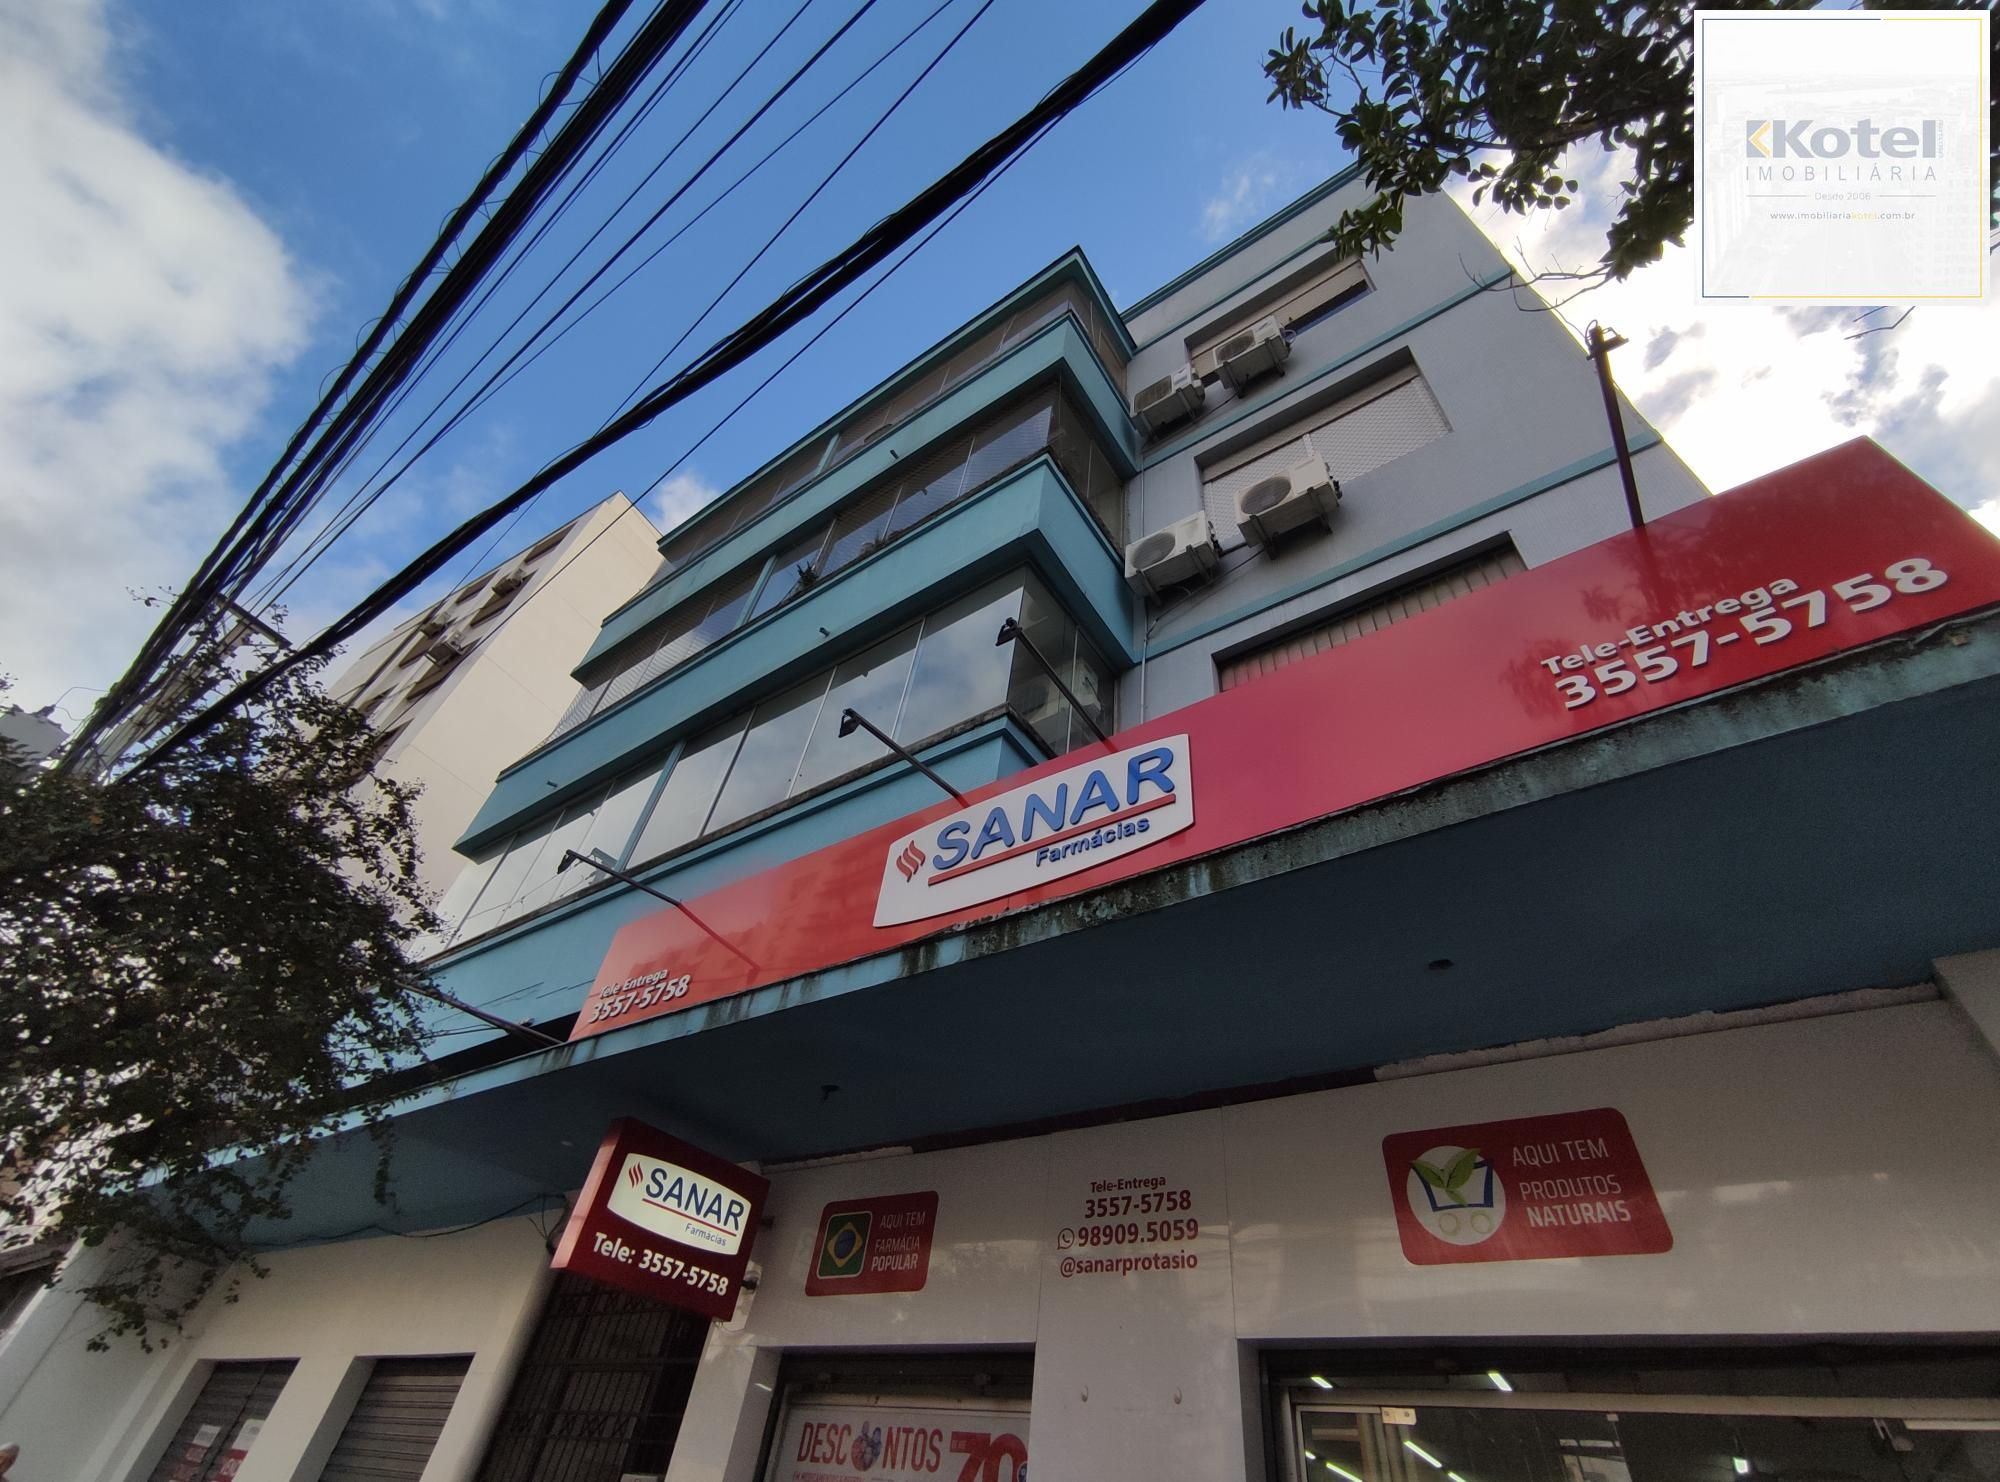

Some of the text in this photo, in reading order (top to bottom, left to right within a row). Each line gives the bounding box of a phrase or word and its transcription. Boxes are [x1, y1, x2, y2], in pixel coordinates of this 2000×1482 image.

[1541, 577, 1799, 675] Tele-Entrega
[1555, 558, 1948, 710] 3557-5758
[932, 747, 1175, 870] SANAR
[1035, 817, 1150, 867] Farmácias
[623, 969, 668, 991] Entrega
[588, 974, 691, 1024] 3557-5758
[1512, 1137, 1609, 1168] AQUI TEM
[1090, 1176, 1167, 1193] Tele-Entrega
[1519, 1174, 1622, 1201] PRODUTOS
[645, 1168, 745, 1231] SANAR
[1084, 1189, 1192, 1219] 3557-5758
[1526, 1200, 1631, 1228] NATURAIS
[880, 1211, 926, 1229] AQUI TEM
[1078, 1218, 1199, 1247] 98909.5059
[874, 1233, 920, 1253] FARMÁCIA
[593, 1232, 729, 1296] Tele: 3557-5758
[871, 1253, 918, 1272] POPULAR
[1060, 1249, 1198, 1278] @sanarprotasio
